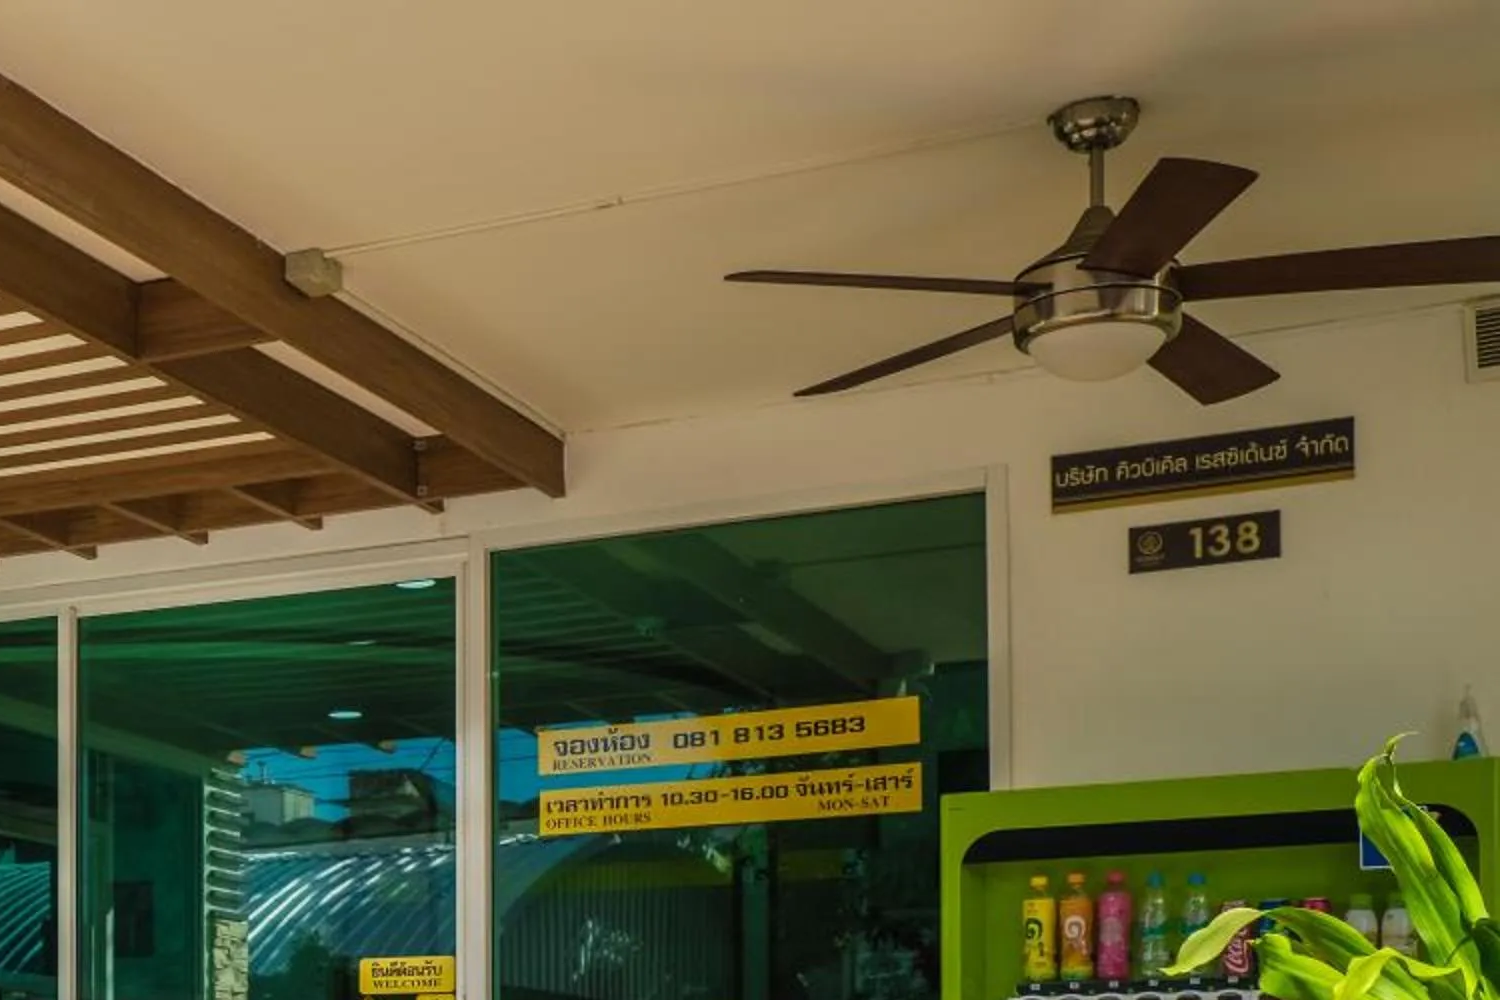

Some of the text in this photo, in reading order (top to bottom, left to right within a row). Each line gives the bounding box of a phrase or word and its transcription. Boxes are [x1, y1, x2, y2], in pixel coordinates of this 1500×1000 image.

[1056, 465, 1109, 487] บริษัท
[1295, 433, 1349, 457] จำกัด
[1188, 520, 1262, 559] 138
[553, 715, 866, 756] จองห้อง 081 813 5683
[553, 753, 651, 771] RESERVATION
[546, 791, 652, 814] เวลาทำการ
[661, 783, 789, 808] 10.30-16.00
[603, 812, 652, 826] HOURS
[373, 978, 442, 989] WELCOME
